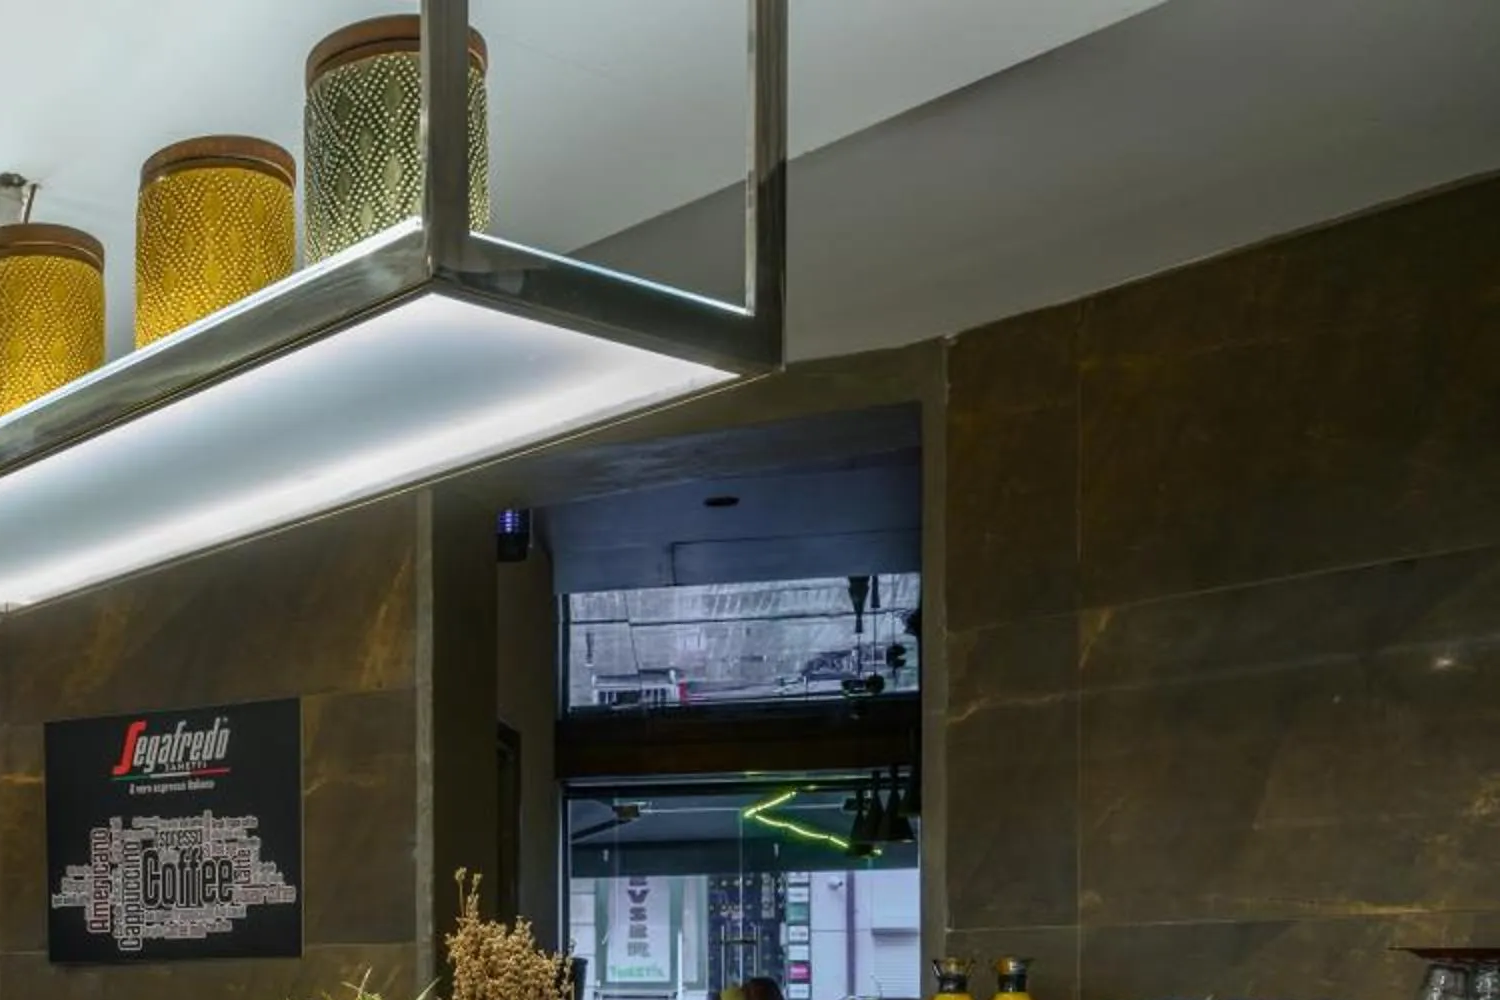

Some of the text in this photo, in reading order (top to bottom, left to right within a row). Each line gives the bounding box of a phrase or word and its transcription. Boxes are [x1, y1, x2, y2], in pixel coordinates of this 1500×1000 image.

[111, 716, 232, 776] Segafredo
[89, 829, 111, 931] Americano
[121, 841, 143, 949] Cappuccino
[142, 847, 234, 909] Coffee
